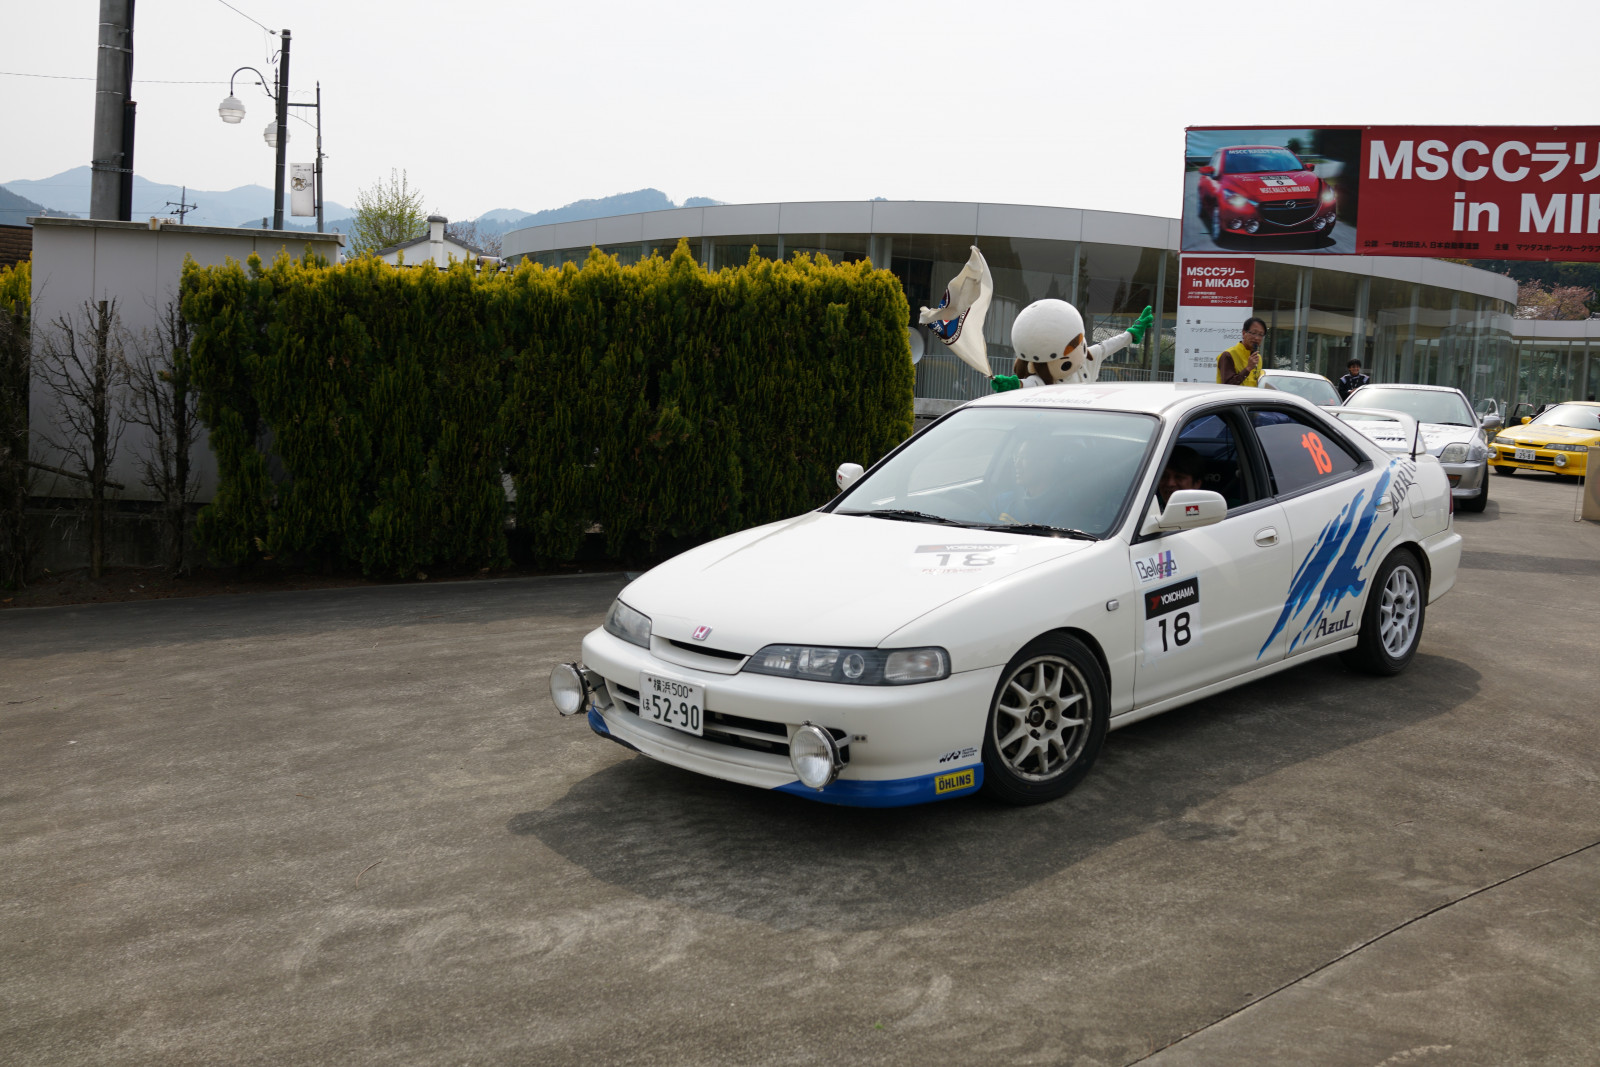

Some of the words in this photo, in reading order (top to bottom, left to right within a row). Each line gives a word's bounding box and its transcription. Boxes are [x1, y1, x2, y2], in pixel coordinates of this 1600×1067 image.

[1453, 191, 1500, 232] in
[1186, 266, 1245, 276] MSCCラリー
[1192, 278, 1203, 287] in
[1205, 278, 1250, 288] MIKABO
[1301, 431, 1333, 475] 18
[936, 553, 997, 566] 18
[1160, 585, 1195, 606] YOKOHAMA
[1158, 611, 1192, 652] 18
[652, 694, 700, 731] 52-90
[938, 773, 972, 791] ÖHLINS
